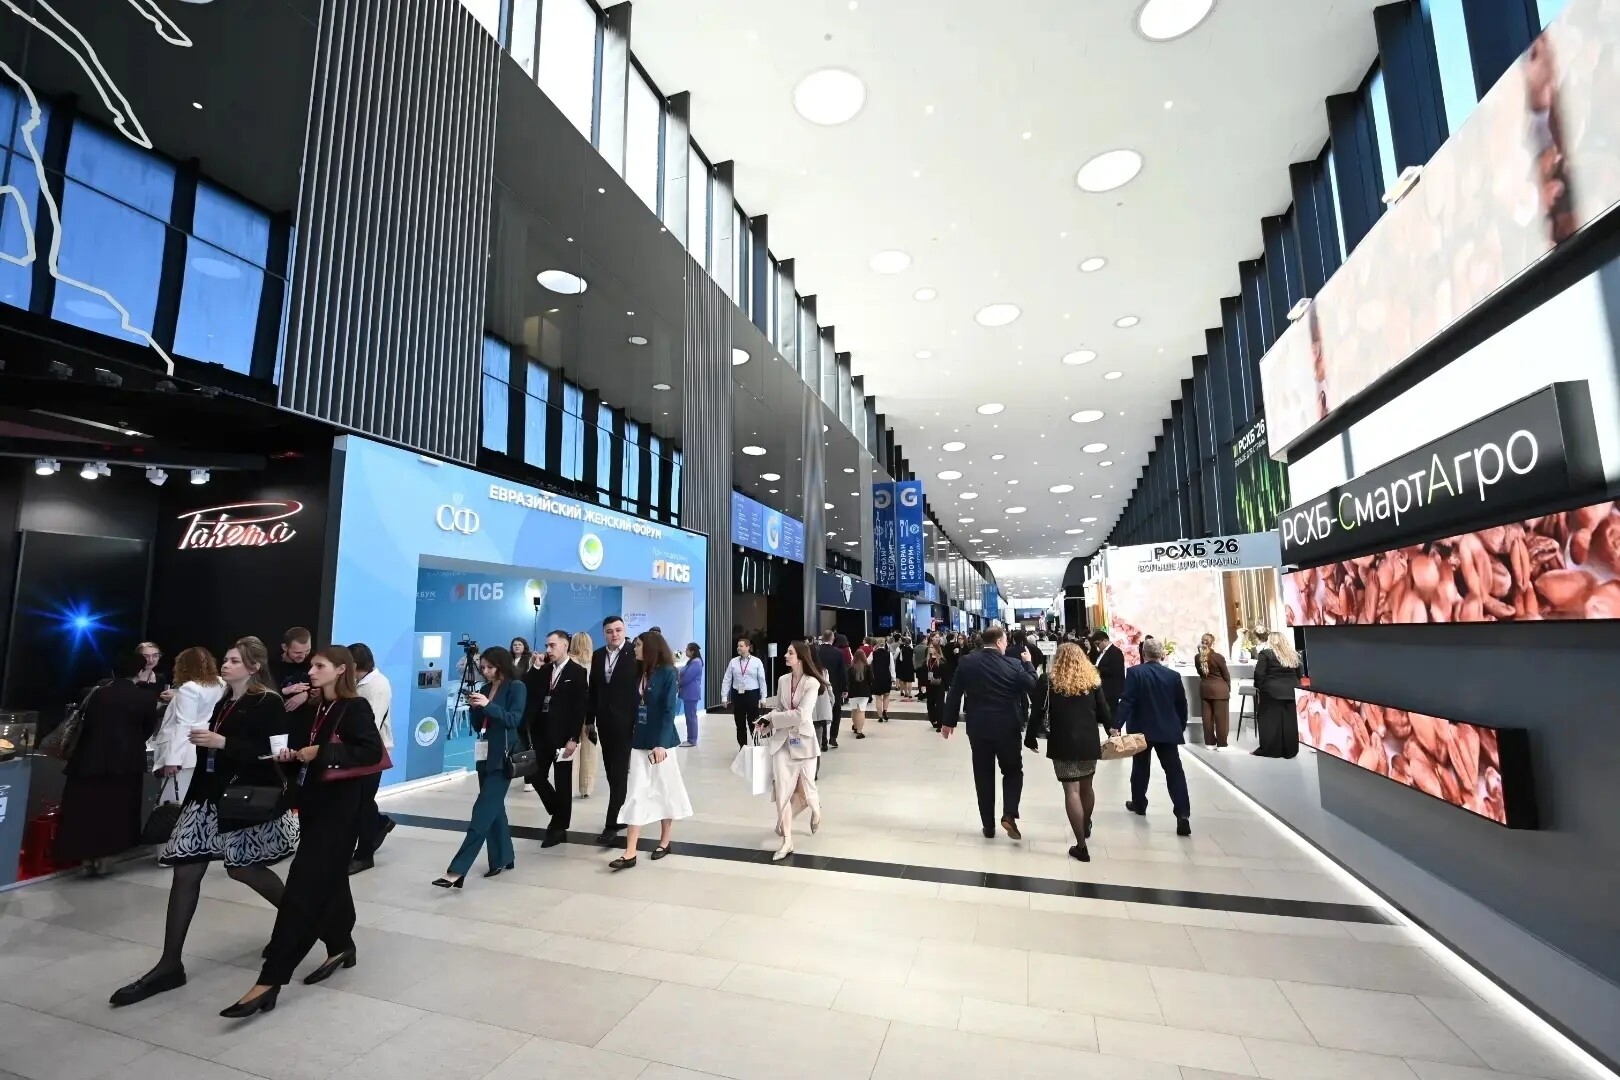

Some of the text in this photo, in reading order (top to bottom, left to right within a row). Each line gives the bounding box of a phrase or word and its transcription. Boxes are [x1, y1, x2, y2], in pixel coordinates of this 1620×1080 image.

[900, 487, 918, 507] G
[1282, 429, 1539, 550] РСХБ-СмартАгро
[177, 500, 303, 549] Ракета
[436, 504, 480, 535] СФ
[489, 484, 662, 540] ЕВРАЗИЙСКИЙ ЖЕНСКИЙ ФОРУМ
[766, 515, 779, 550] G
[665, 561, 691, 583] ПСБ
[1137, 556, 1240, 573] БОЛЬШЕ ДЛЯ СТРАНЫ
[467, 582, 504, 601] ПСБ
